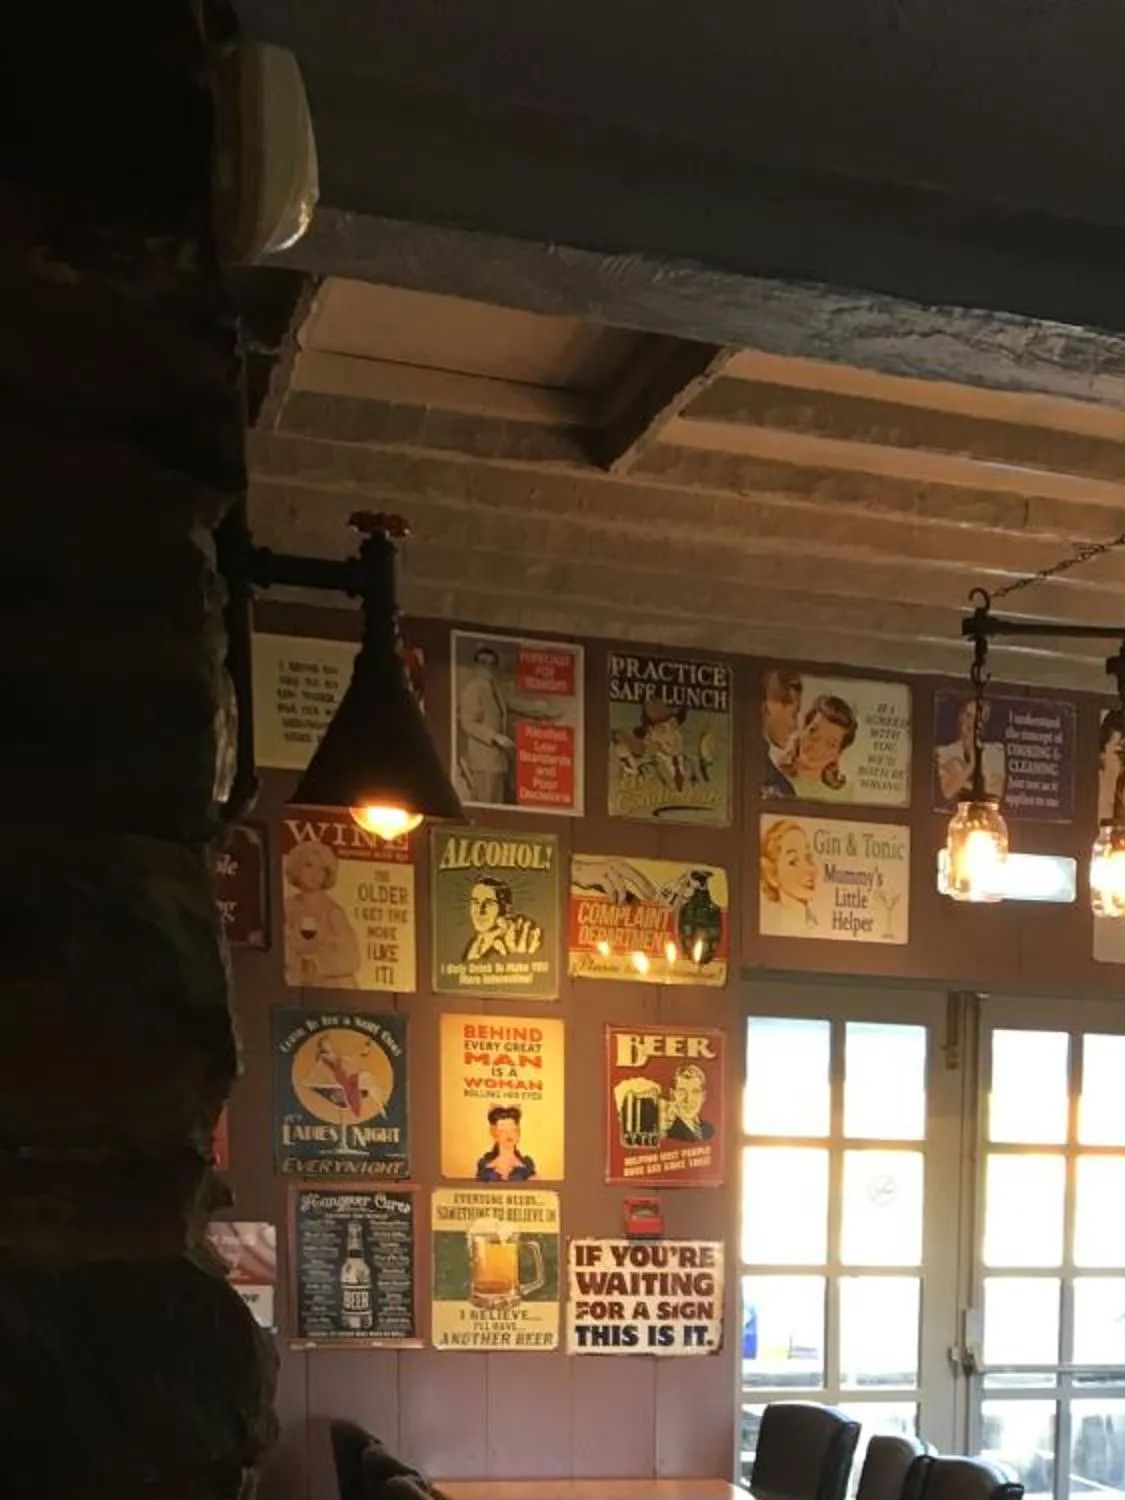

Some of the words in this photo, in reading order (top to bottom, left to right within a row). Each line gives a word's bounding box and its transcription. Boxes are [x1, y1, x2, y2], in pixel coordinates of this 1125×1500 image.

[609, 656, 728, 687] PRACTICE
[609, 680, 655, 701] SAFE
[661, 684, 728, 710] LUNCH
[282, 819, 410, 851] WINE
[813, 829, 841, 857] Gin
[845, 832, 858, 857] &
[862, 833, 905, 861] Tonic
[439, 835, 553, 870] ALCOHOL!
[358, 883, 408, 905] OLDER
[834, 887, 869, 909] Little
[362, 907, 384, 921] GET
[388, 908, 408, 924] THE
[577, 901, 673, 928] COMPLAINT
[832, 910, 875, 936] Helper
[367, 926, 398, 941] MORE
[577, 926, 672, 951] DEPARTMENT
[367, 941, 371, 960] I
[463, 1024, 543, 1042] BEHIND
[463, 1040, 500, 1051] EVERY
[503, 1042, 542, 1053] GREAT
[615, 1033, 717, 1068] BEER
[463, 1052, 543, 1069] MAN
[463, 1077, 543, 1091] WOMAN
[463, 1089, 501, 1099] ROLLING
[503, 1090, 520, 1100] HER
[521, 1090, 543, 1101] EYES
[352, 1126, 401, 1148] NIGHT
[623, 1153, 659, 1166] HELPING
[660, 1151, 680, 1162] UGLY
[681, 1147, 712, 1158] PEOPLE
[623, 1166, 645, 1177] HAVE
[646, 1164, 663, 1175] SEX
[664, 1160, 689, 1173] SINCE
[300, 1193, 373, 1212] Hangover
[374, 1193, 411, 1213] Cures
[453, 1193, 503, 1205] EVERYONE
[437, 1207, 492, 1220] SOMETHING
[507, 1208, 546, 1222] BELIEVE
[575, 1246, 601, 1267] IF
[611, 1246, 715, 1268] YOU'RE
[575, 1272, 715, 1297] WAITING
[342, 1291, 369, 1309] BEER
[575, 1302, 624, 1320] FOR
[632, 1302, 650, 1320] A
[656, 1302, 713, 1320] SIGN
[439, 1332, 511, 1346] ANOTHER
[516, 1332, 552, 1346] BEER
[574, 1325, 640, 1347] THIS
[649, 1325, 675, 1347] IS
[683, 1325, 715, 1347] IT.
